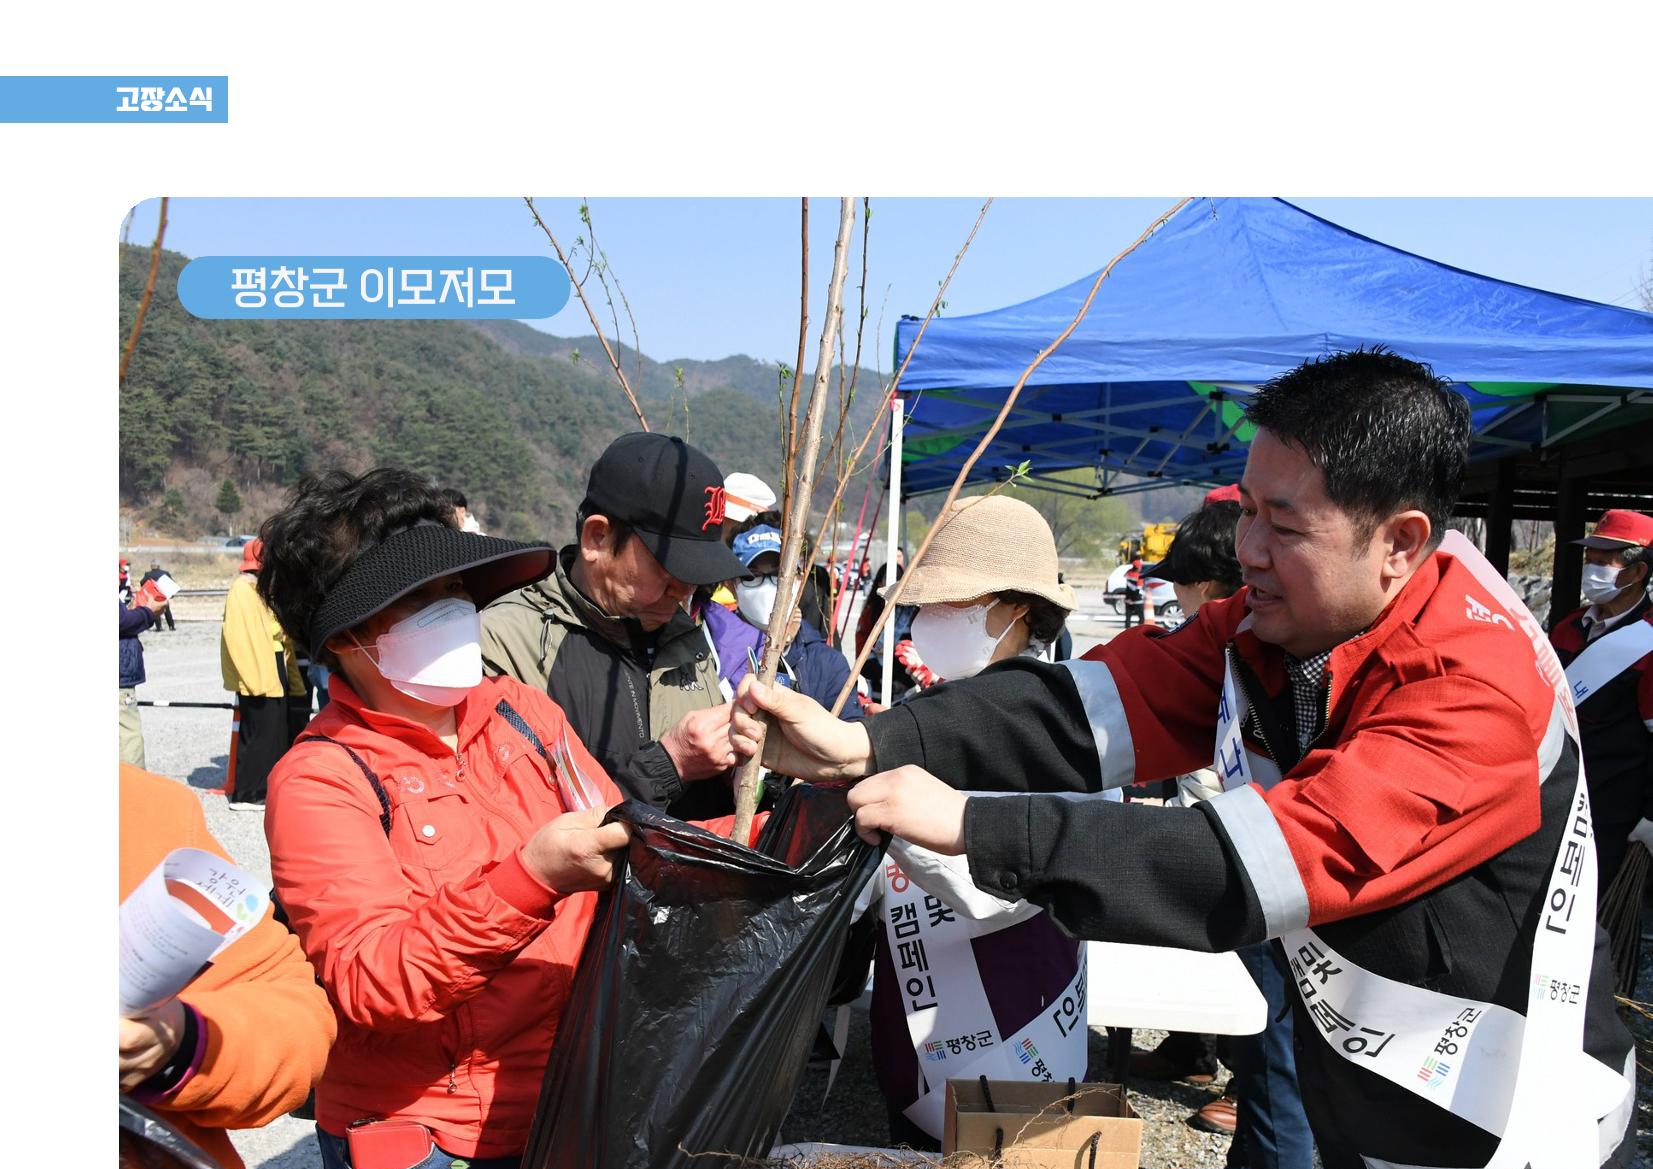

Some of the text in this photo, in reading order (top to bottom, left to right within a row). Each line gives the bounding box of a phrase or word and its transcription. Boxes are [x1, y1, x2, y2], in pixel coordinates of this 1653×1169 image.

[117, 88, 211, 111] 고장소식
[890, 902, 938, 1012] 캠페인
[1298, 941, 1343, 985] 및
[1290, 957, 1396, 1058] 캠페인
[1550, 979, 1581, 1005] 평창군
[945, 1030, 994, 1055] 평창군
[1434, 1007, 1482, 1055] 평창군
